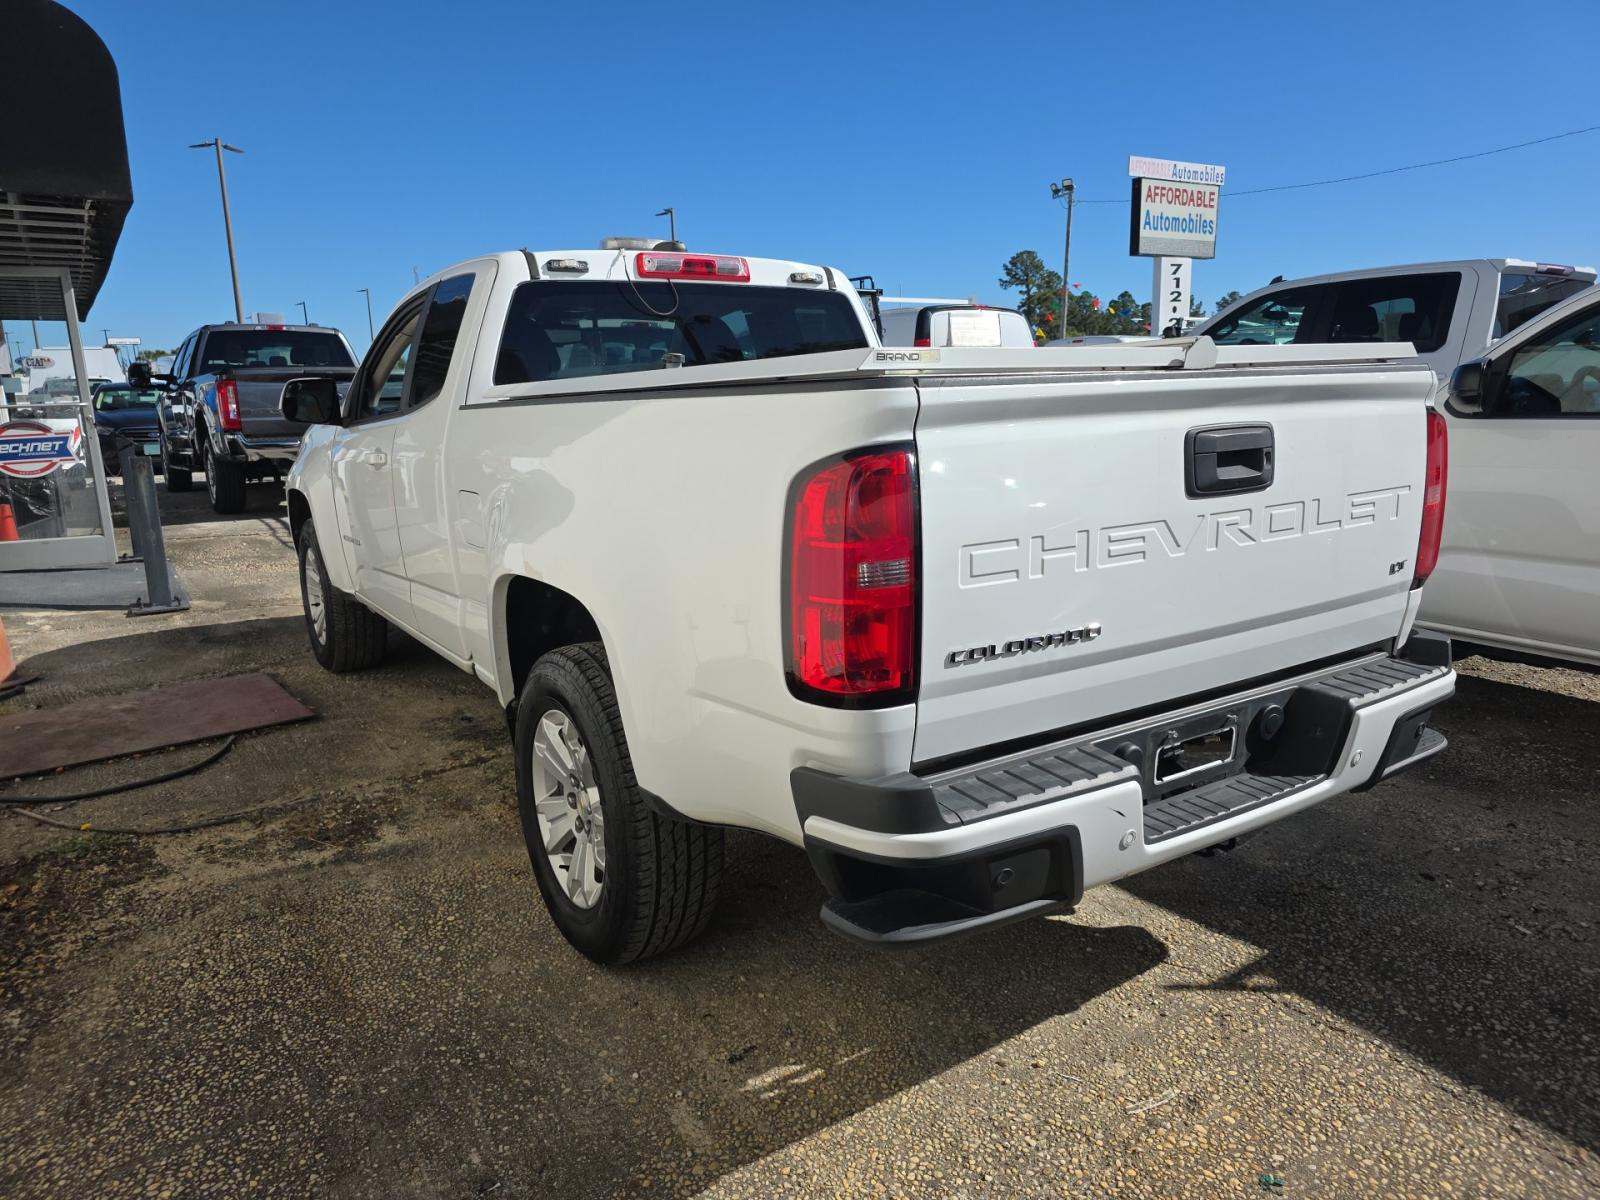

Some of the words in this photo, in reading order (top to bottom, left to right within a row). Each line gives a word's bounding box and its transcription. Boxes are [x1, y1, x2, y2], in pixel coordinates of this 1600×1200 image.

[1172, 164, 1224, 183] Automobiles
[1145, 185, 1216, 208] AFFORDABLE
[1143, 209, 1214, 235] Automobiles
[876, 352, 920, 361] BRAND
[958, 485, 1412, 588] CHEVROLET
[943, 622, 1102, 669] COLORADO
